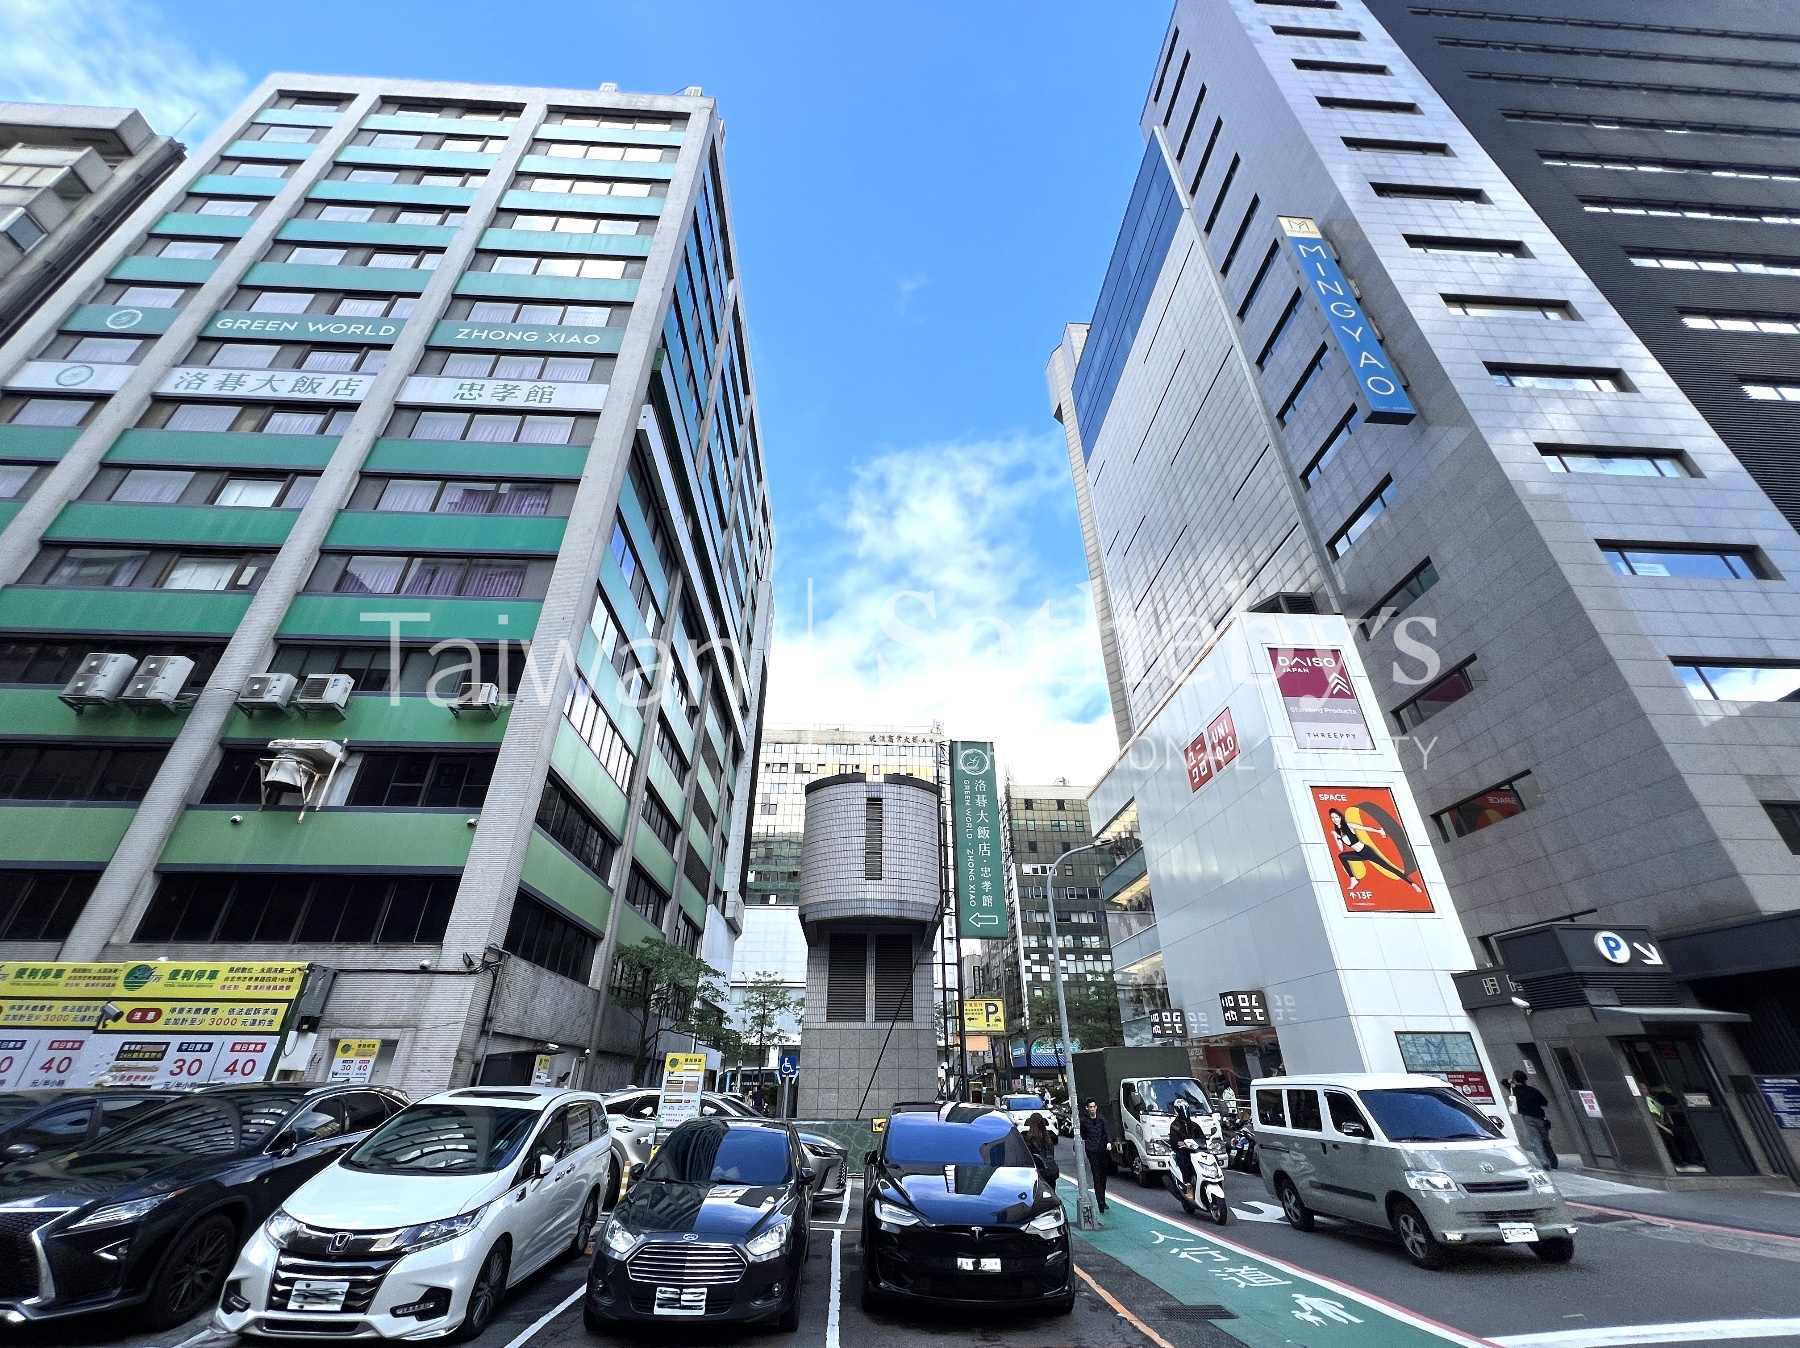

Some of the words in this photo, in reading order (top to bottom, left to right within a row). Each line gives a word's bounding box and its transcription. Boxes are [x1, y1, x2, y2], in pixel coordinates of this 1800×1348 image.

[216, 318, 298, 332] GREEN
[307, 321, 396, 336] WORLD
[1298, 244, 1395, 395] MINGYAO
[454, 328, 539, 342] ZHONG
[544, 332, 601, 345] XIAO
[173, 371, 363, 397] 洛碁大飯店
[453, 382, 557, 404] 忠孝館
[1277, 656, 1336, 668] DAISO
[1324, 707, 1357, 715] Products
[1211, 719, 1229, 744] UNI
[1306, 732, 1357, 740] THREEPPY
[1215, 736, 1235, 762] QLO
[963, 779, 971, 806] GREEN
[1318, 793, 1348, 801] SPACE
[965, 807, 973, 839] WORLD
[966, 848, 975, 881] ZHONG
[968, 883, 977, 907] XIAO
[1356, 891, 1372, 900] 13F
[1602, 936, 1622, 959] P
[167, 968, 220, 982] 便利停車
[43, 1013, 70, 1022] 3000
[208, 1017, 238, 1026] 3000
[985, 1003, 999, 1022] P
[39, 1056, 72, 1073] 40
[169, 1058, 203, 1076] 30
[224, 1058, 257, 1076] 40
